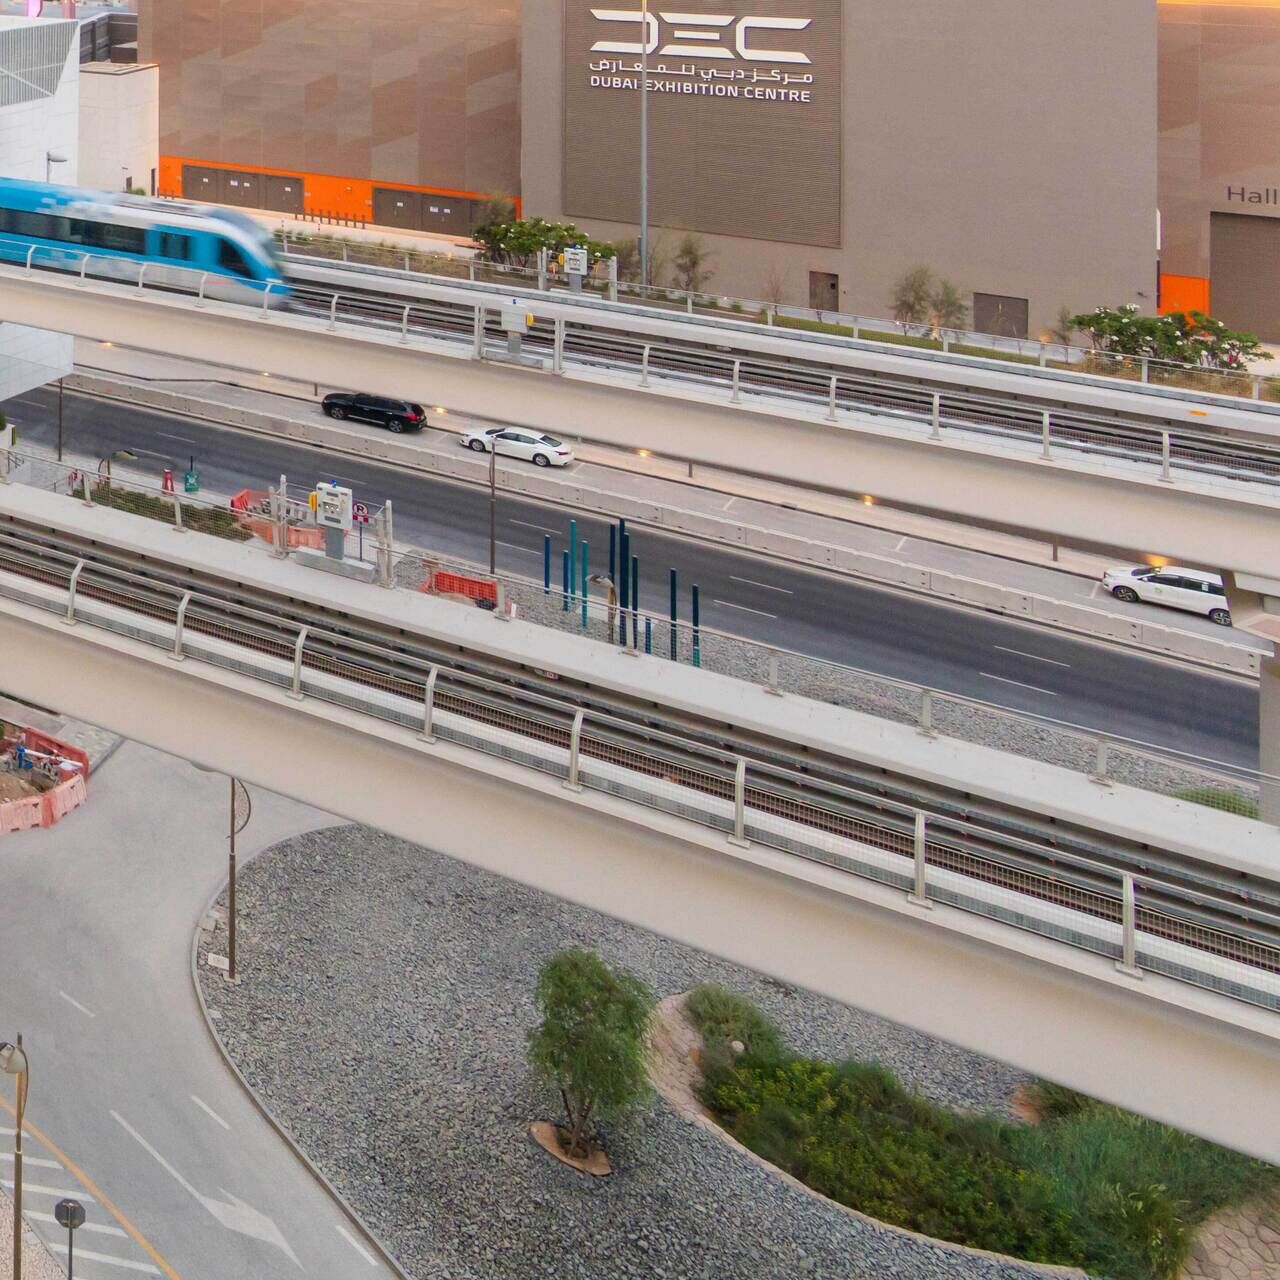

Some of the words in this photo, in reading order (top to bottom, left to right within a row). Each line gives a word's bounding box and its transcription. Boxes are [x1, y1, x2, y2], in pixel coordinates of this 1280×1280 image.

[589, 9, 812, 63] DEC
[589, 59, 696, 76] للمعارض
[700, 68, 745, 81] دبي
[751, 68, 813, 85] مركز
[590, 75, 638, 90] DUBAI
[643, 79, 739, 97] EXHIBITION
[743, 86, 811, 103] CENTRE
[1227, 186, 1278, 205] Hall
